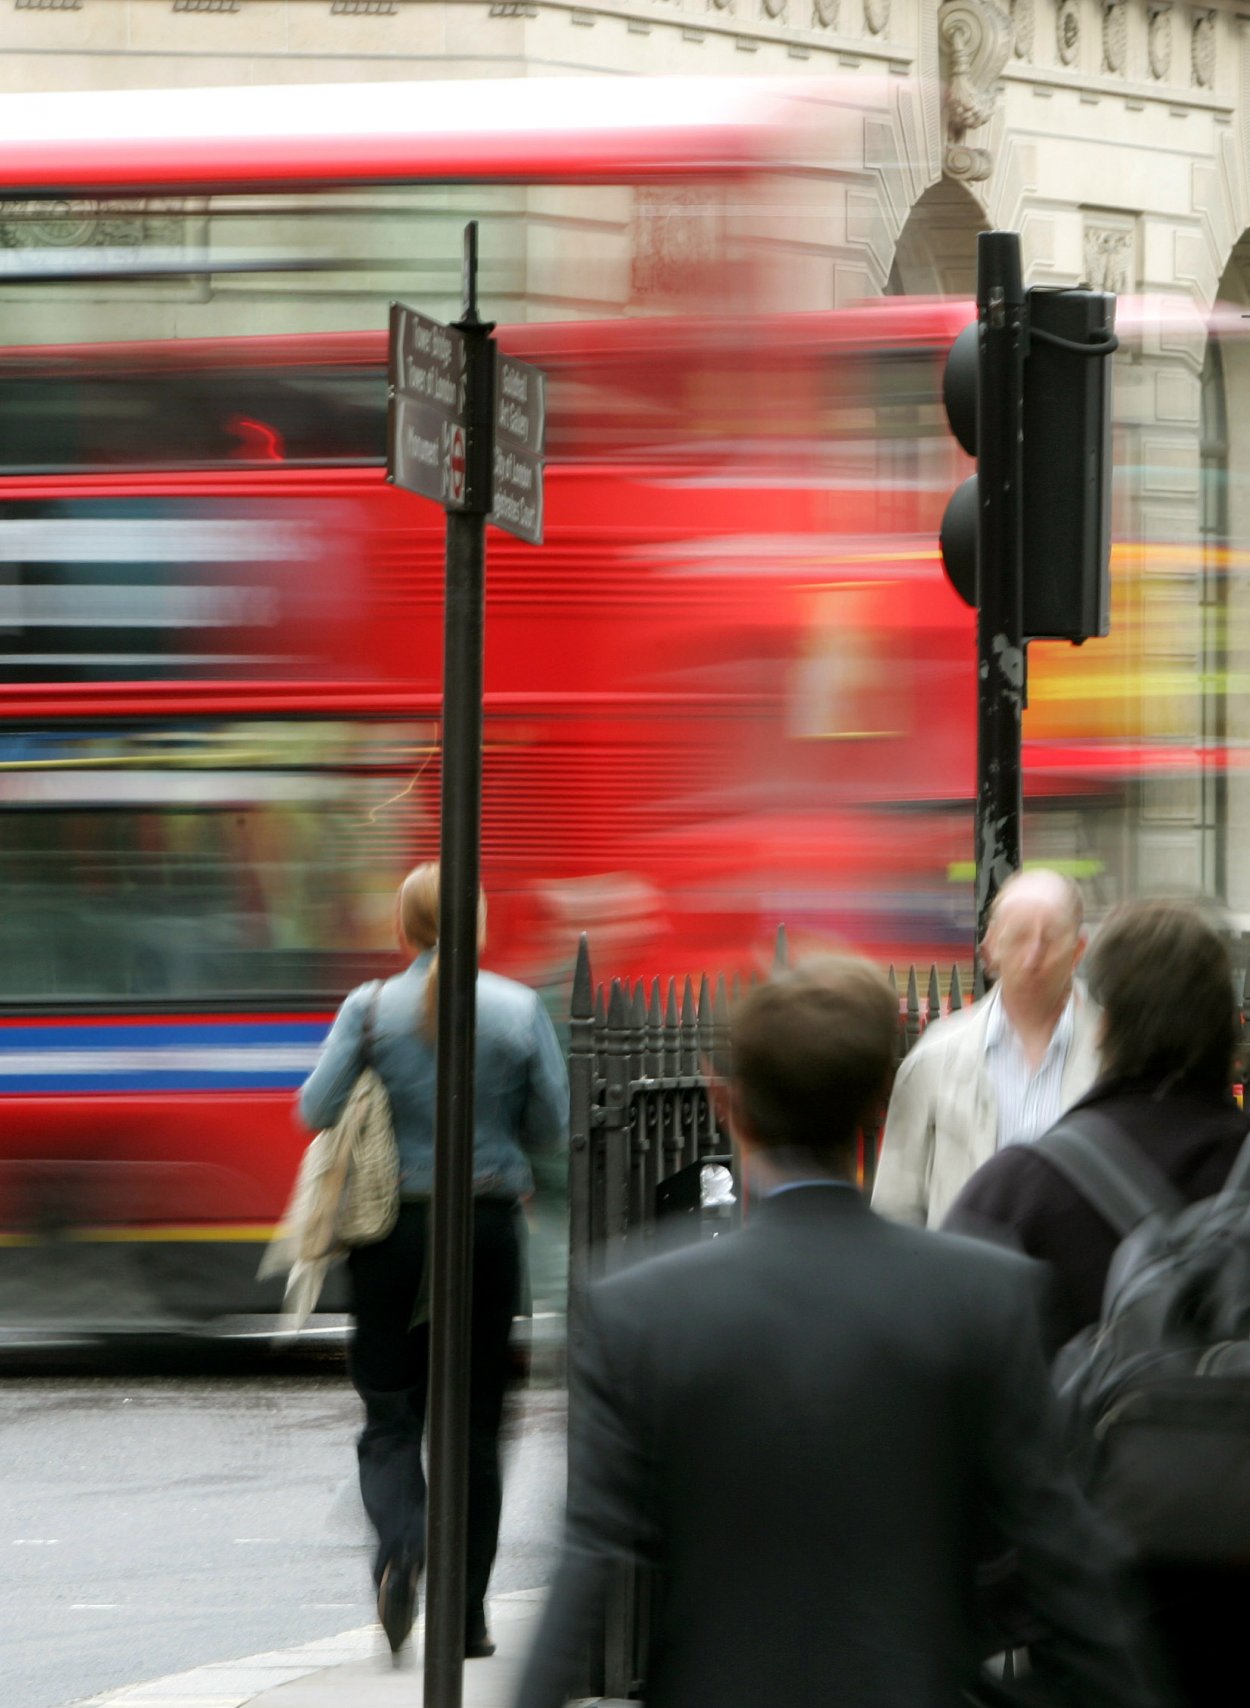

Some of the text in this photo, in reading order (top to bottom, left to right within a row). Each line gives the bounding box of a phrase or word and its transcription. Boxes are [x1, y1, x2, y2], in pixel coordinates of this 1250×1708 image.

[413, 316, 452, 368] Tower Bridge
[407, 355, 427, 391] Tower
[434, 366, 456, 404] London
[407, 424, 439, 466] Monument
